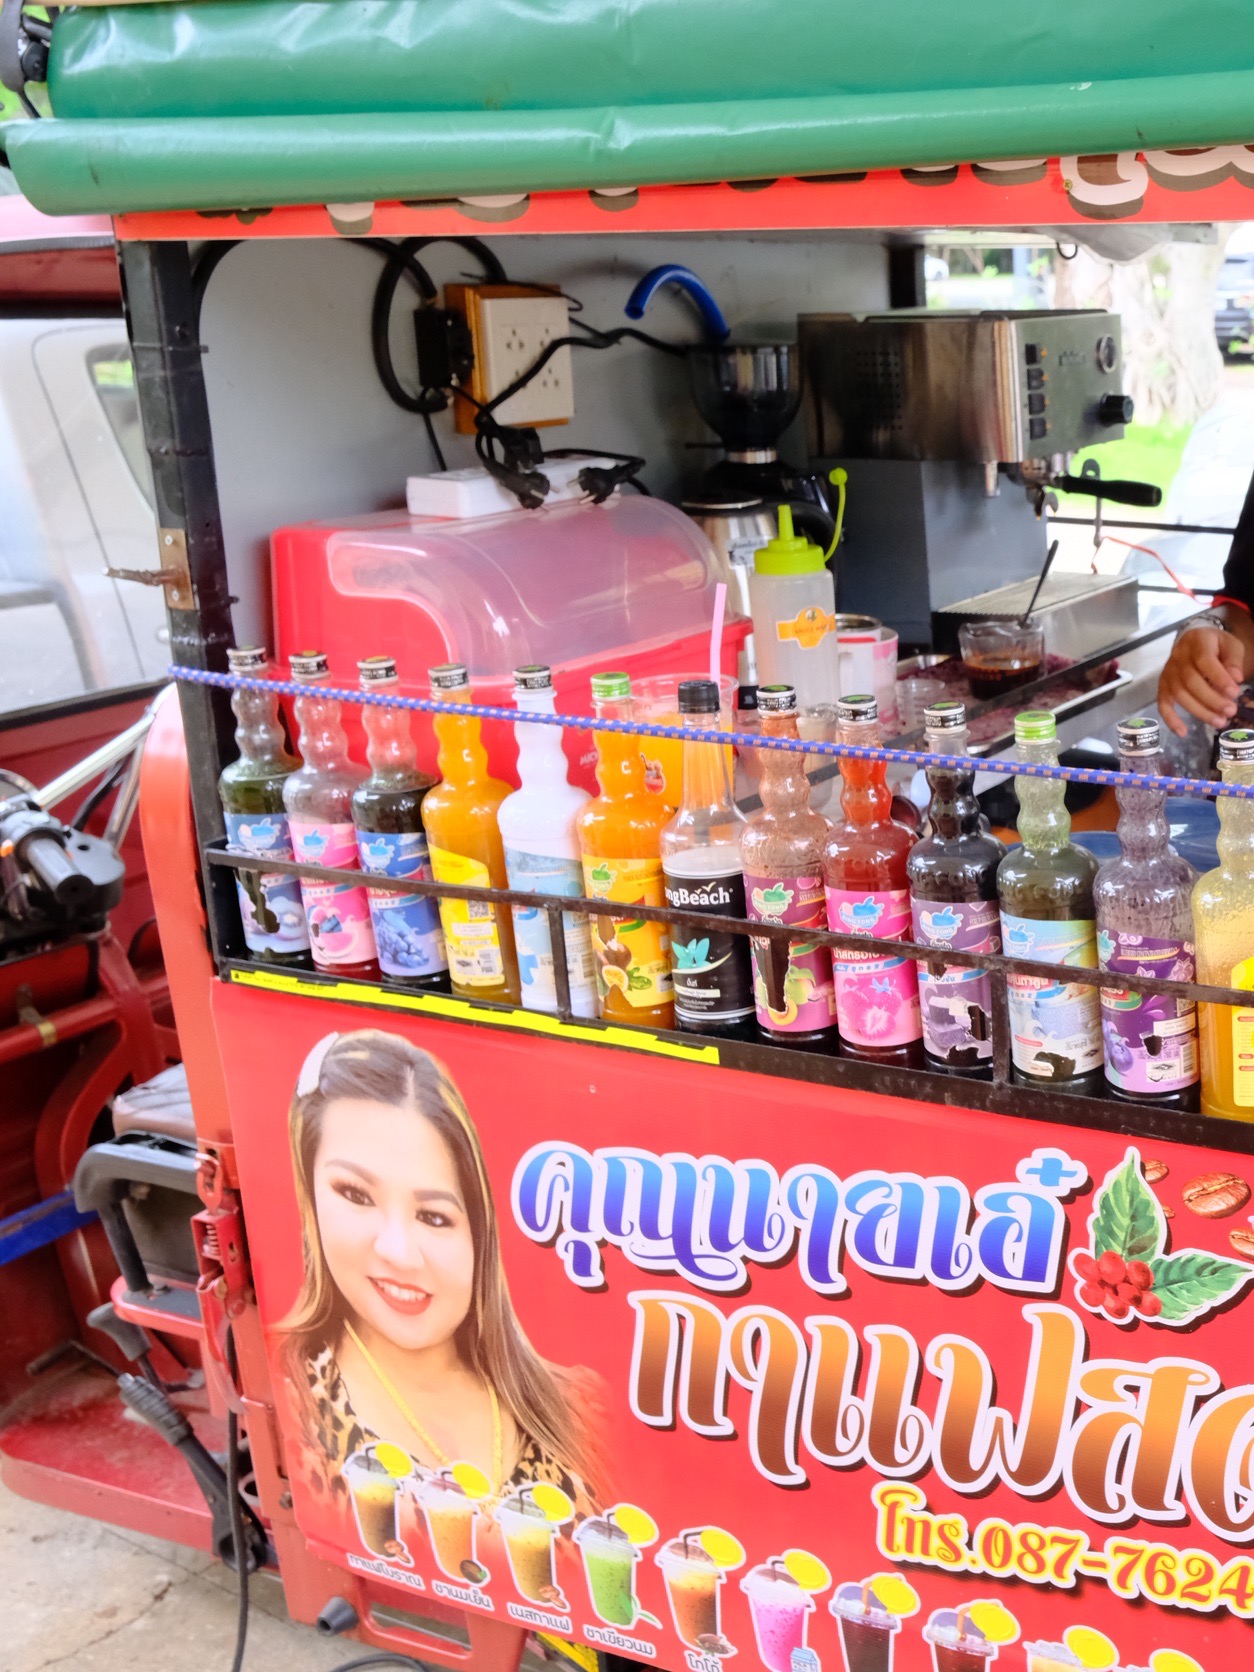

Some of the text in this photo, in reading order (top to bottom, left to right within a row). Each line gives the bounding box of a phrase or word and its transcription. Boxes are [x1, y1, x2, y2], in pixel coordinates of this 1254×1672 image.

[349, 1553, 423, 1589] กาแฟโบราณ
[509, 1604, 571, 1632] เนสกาแฟ
[586, 1624, 654, 1657] ชาเขียวนม
